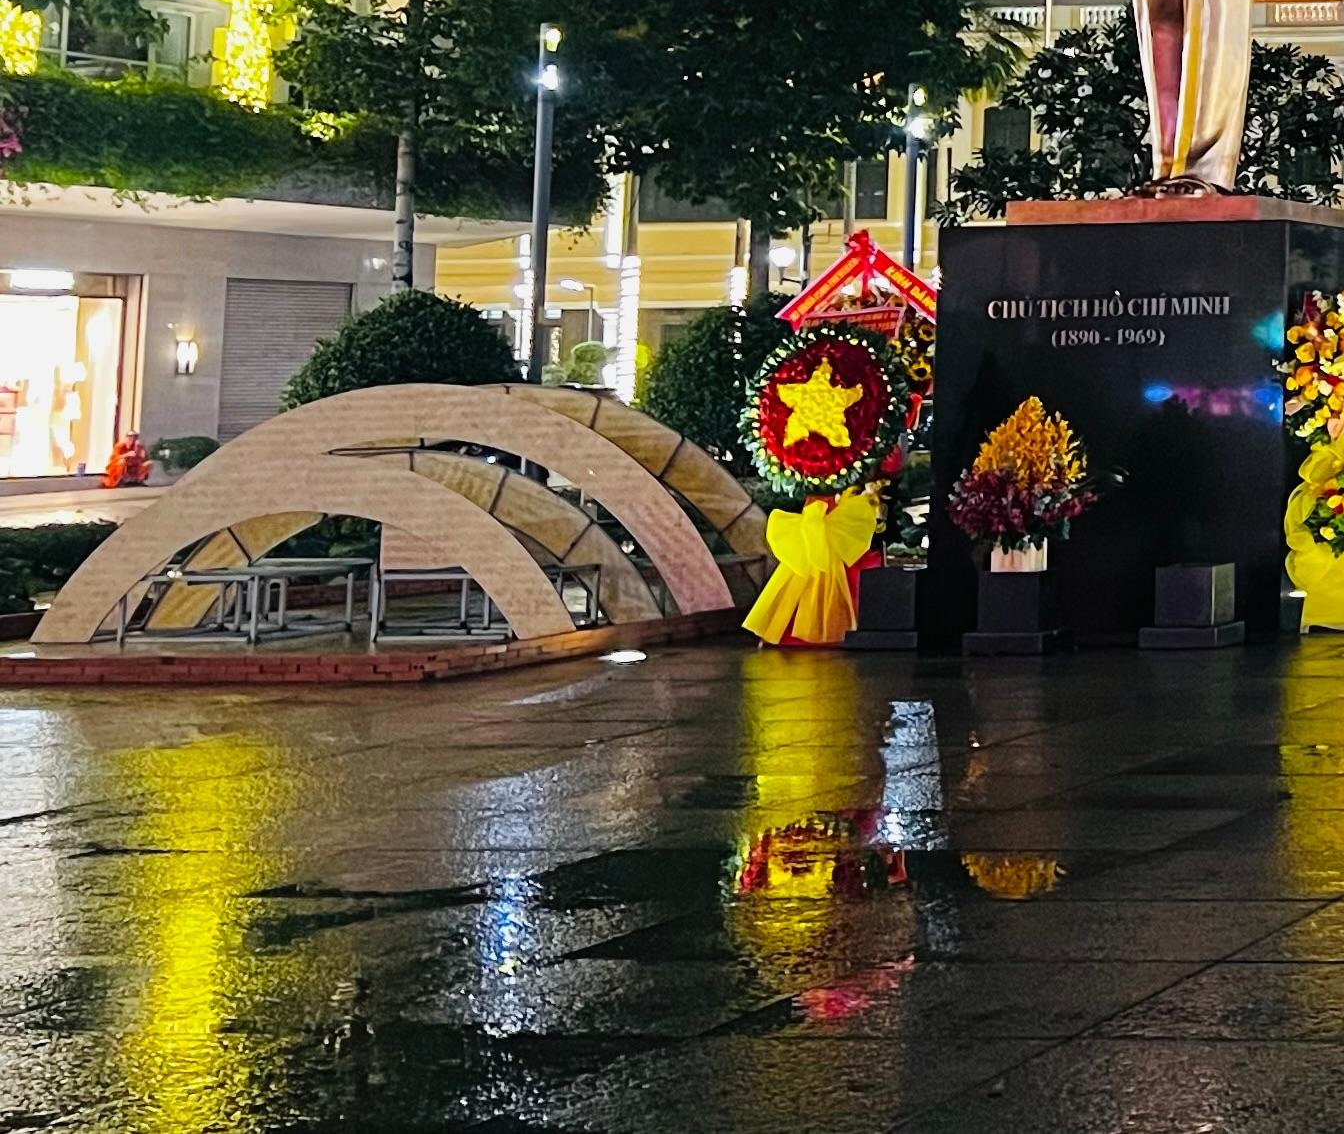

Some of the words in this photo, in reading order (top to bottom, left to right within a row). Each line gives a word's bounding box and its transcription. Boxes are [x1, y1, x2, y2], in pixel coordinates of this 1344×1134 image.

[987, 295, 1033, 319] CHỦ
[1036, 298, 1088, 321] TỊCH
[1093, 290, 1124, 317] HỒ
[1127, 293, 1166, 316] CHÍ
[1170, 296, 1231, 315] MINH
[1051, 329, 1100, 348] (1890
[1117, 328, 1166, 346] 1969)
